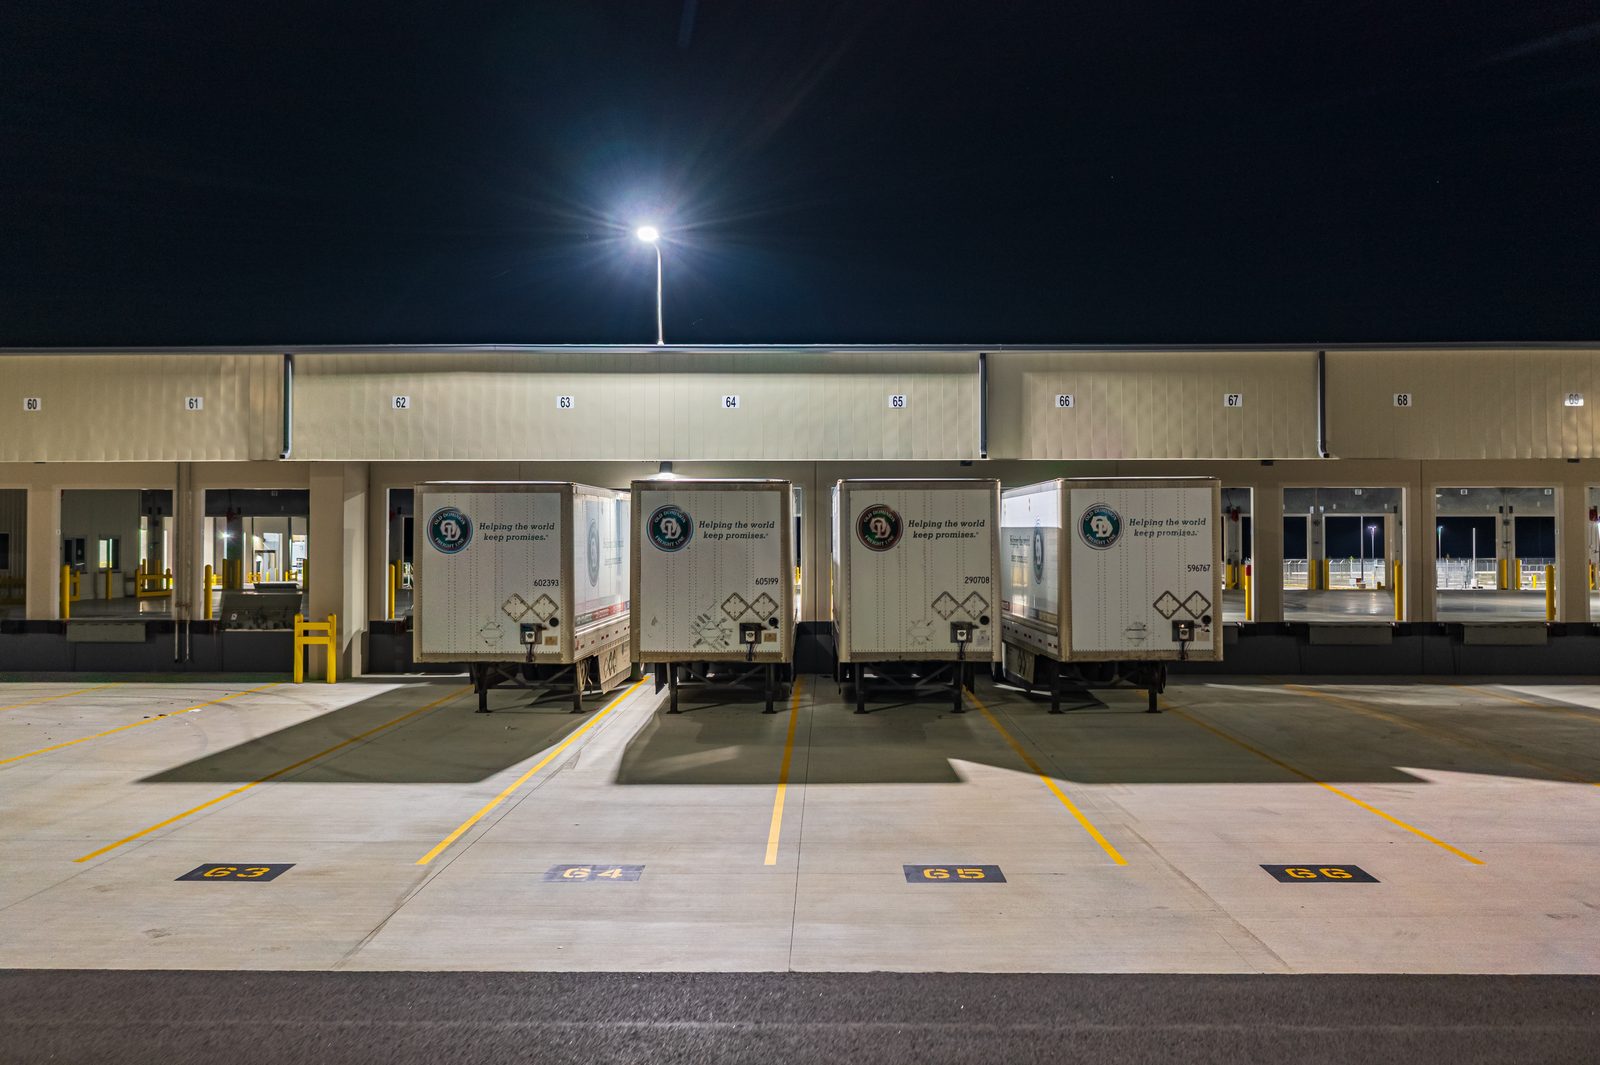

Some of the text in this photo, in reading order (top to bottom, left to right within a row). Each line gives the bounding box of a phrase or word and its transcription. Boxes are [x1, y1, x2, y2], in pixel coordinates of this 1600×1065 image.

[27, 398, 38, 410] 60
[188, 398, 199, 409] 61
[395, 397, 406, 408] 62
[560, 397, 571, 408] 63
[725, 396, 736, 407] 64
[892, 396, 903, 407] 65
[1059, 395, 1070, 406] 66
[1228, 395, 1239, 406] 67
[1397, 394, 1408, 406] 68
[479, 522, 555, 532] Helping the world
[698, 520, 775, 530] Helping the world
[908, 519, 985, 529] Helping the world
[1129, 518, 1207, 528] Helping the world
[483, 533, 504, 542] keep
[703, 531, 724, 541] keep
[913, 531, 933, 540] keep
[1133, 529, 1154, 538] keep
[1187, 564, 1211, 572] 596767
[533, 579, 559, 587] 602393
[755, 578, 779, 586] 605199
[964, 576, 990, 584] 290708
